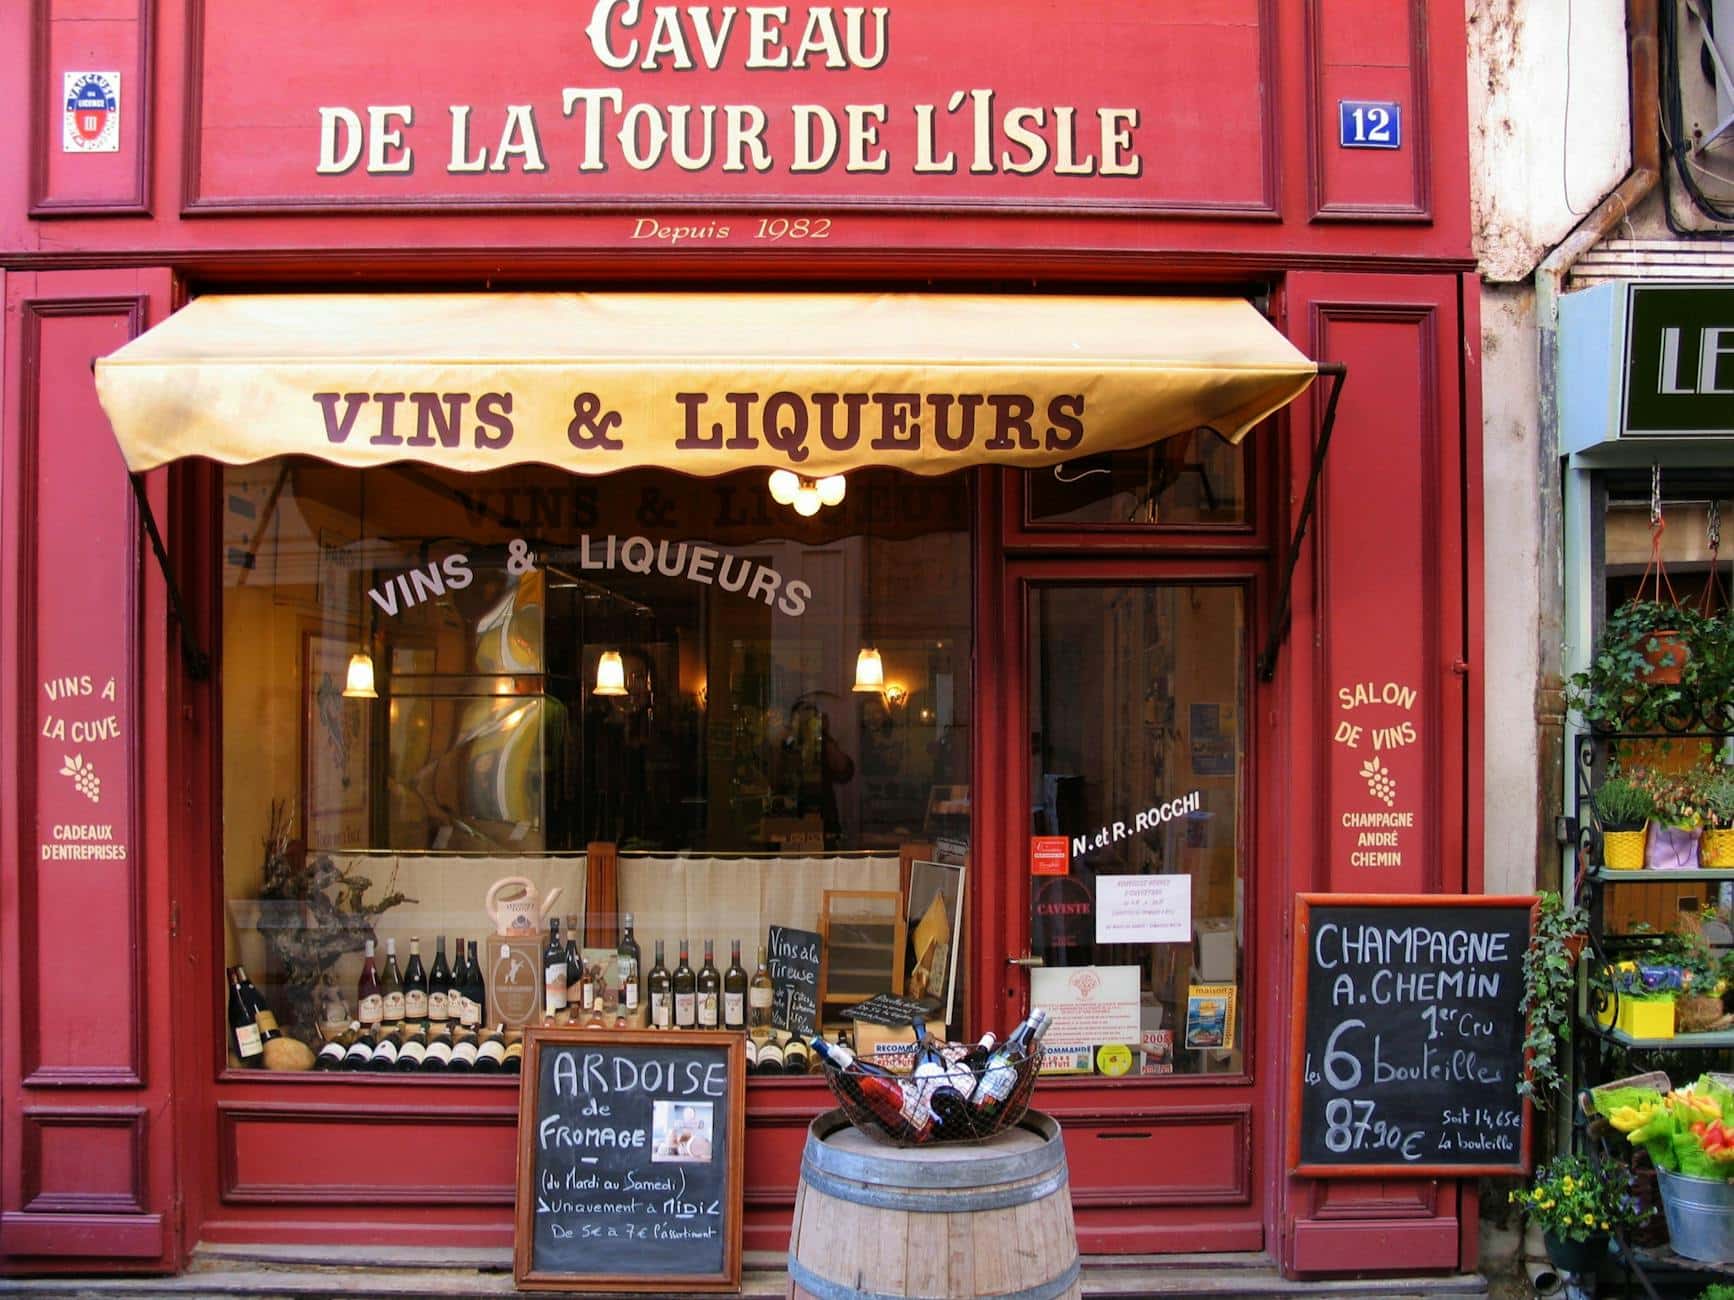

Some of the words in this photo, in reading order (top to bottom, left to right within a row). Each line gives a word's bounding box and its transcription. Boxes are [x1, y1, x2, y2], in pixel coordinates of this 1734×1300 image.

[585, 0, 888, 70] CAVEAU
[316, 105, 413, 173] DE
[446, 105, 545, 173] LA
[562, 87, 773, 172] TOUR
[790, 103, 888, 172] DE
[913, 88, 1142, 177] L'ISLE
[1351, 108, 1390, 142] 12
[631, 218, 730, 244] Depuis
[752, 218, 832, 240] 1982
[312, 392, 514, 450] VINS
[567, 391, 624, 451] &
[675, 392, 1085, 461] LIQUEURS
[368, 553, 474, 617] VINS
[507, 538, 537, 576] &
[581, 535, 813, 617] LIQUEURS
[44, 676, 93, 701] VINS
[1339, 682, 1417, 710] SALON
[42, 715, 65, 741] LA
[72, 716, 120, 743] CUVE
[1335, 721, 1363, 748] DE
[1372, 722, 1416, 750] VINS
[1136, 791, 1200, 832] ROCCHI
[1342, 813, 1413, 828] CHAMPAGNE
[53, 825, 112, 840] CADEAUX
[1358, 830, 1398, 847] ANDRÉ
[1351, 852, 1401, 867] CHEMIN
[1315, 924, 1510, 968] CHAMPAGNE
[1459, 1014, 1494, 1038] Cru
[1324, 1019, 1366, 1091] 6
[553, 1052, 726, 1097] ARDOISE
[582, 1098, 611, 1117] de
[540, 1114, 646, 1150] FROMAGE
[565, 1166, 600, 1191] Mardi
[604, 1178, 620, 1191] au
[552, 1224, 574, 1239] De
